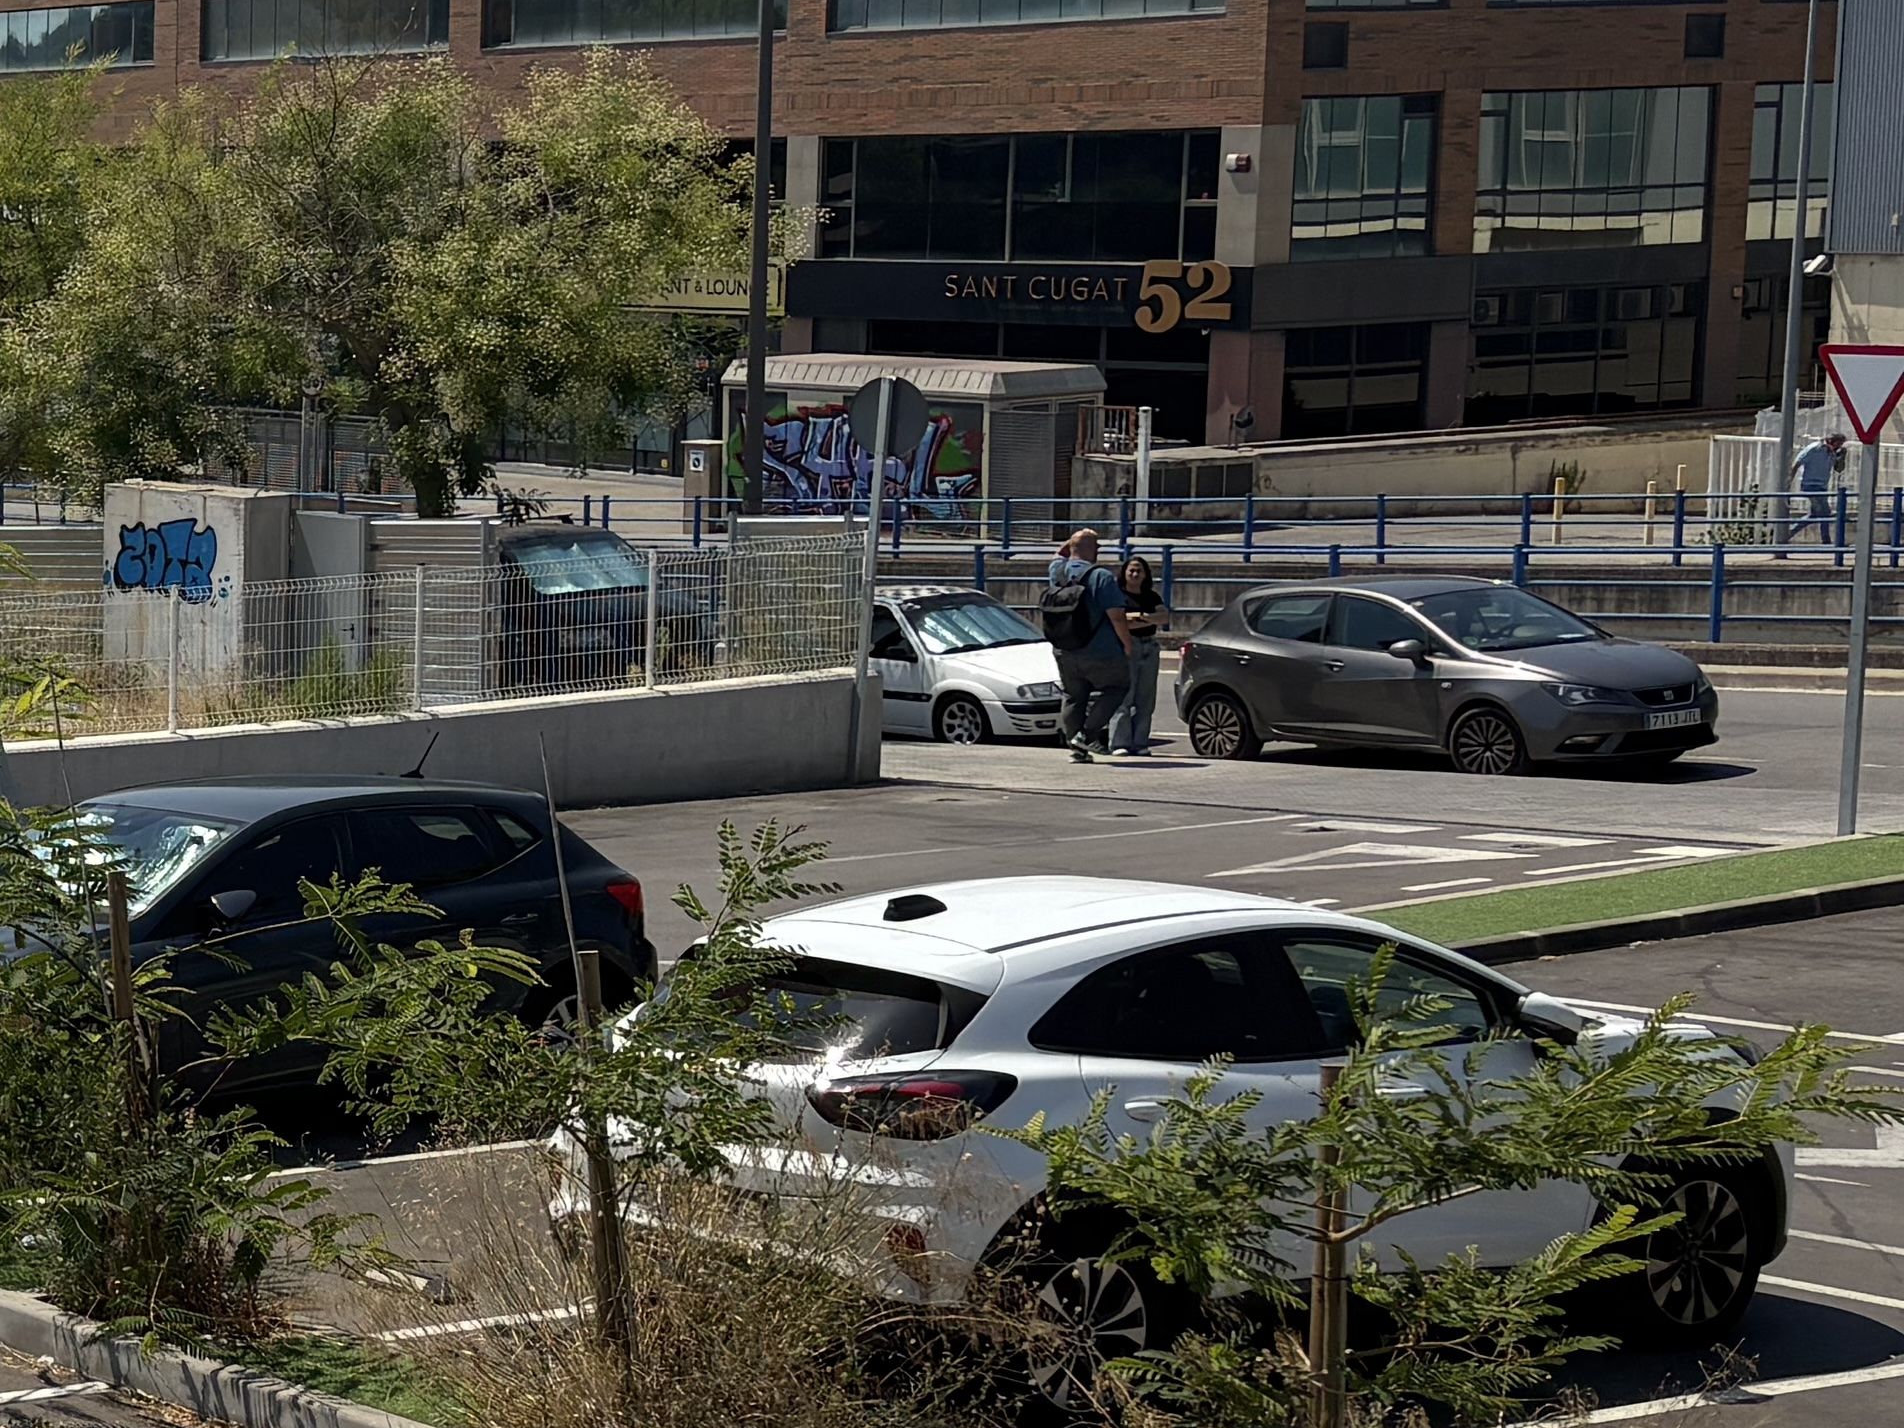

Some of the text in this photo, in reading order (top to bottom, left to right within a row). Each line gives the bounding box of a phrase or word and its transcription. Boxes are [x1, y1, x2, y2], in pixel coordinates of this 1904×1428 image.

[944, 274, 1017, 299] SANT
[1028, 275, 1129, 301] CUGAT
[1134, 259, 1232, 333] 52
